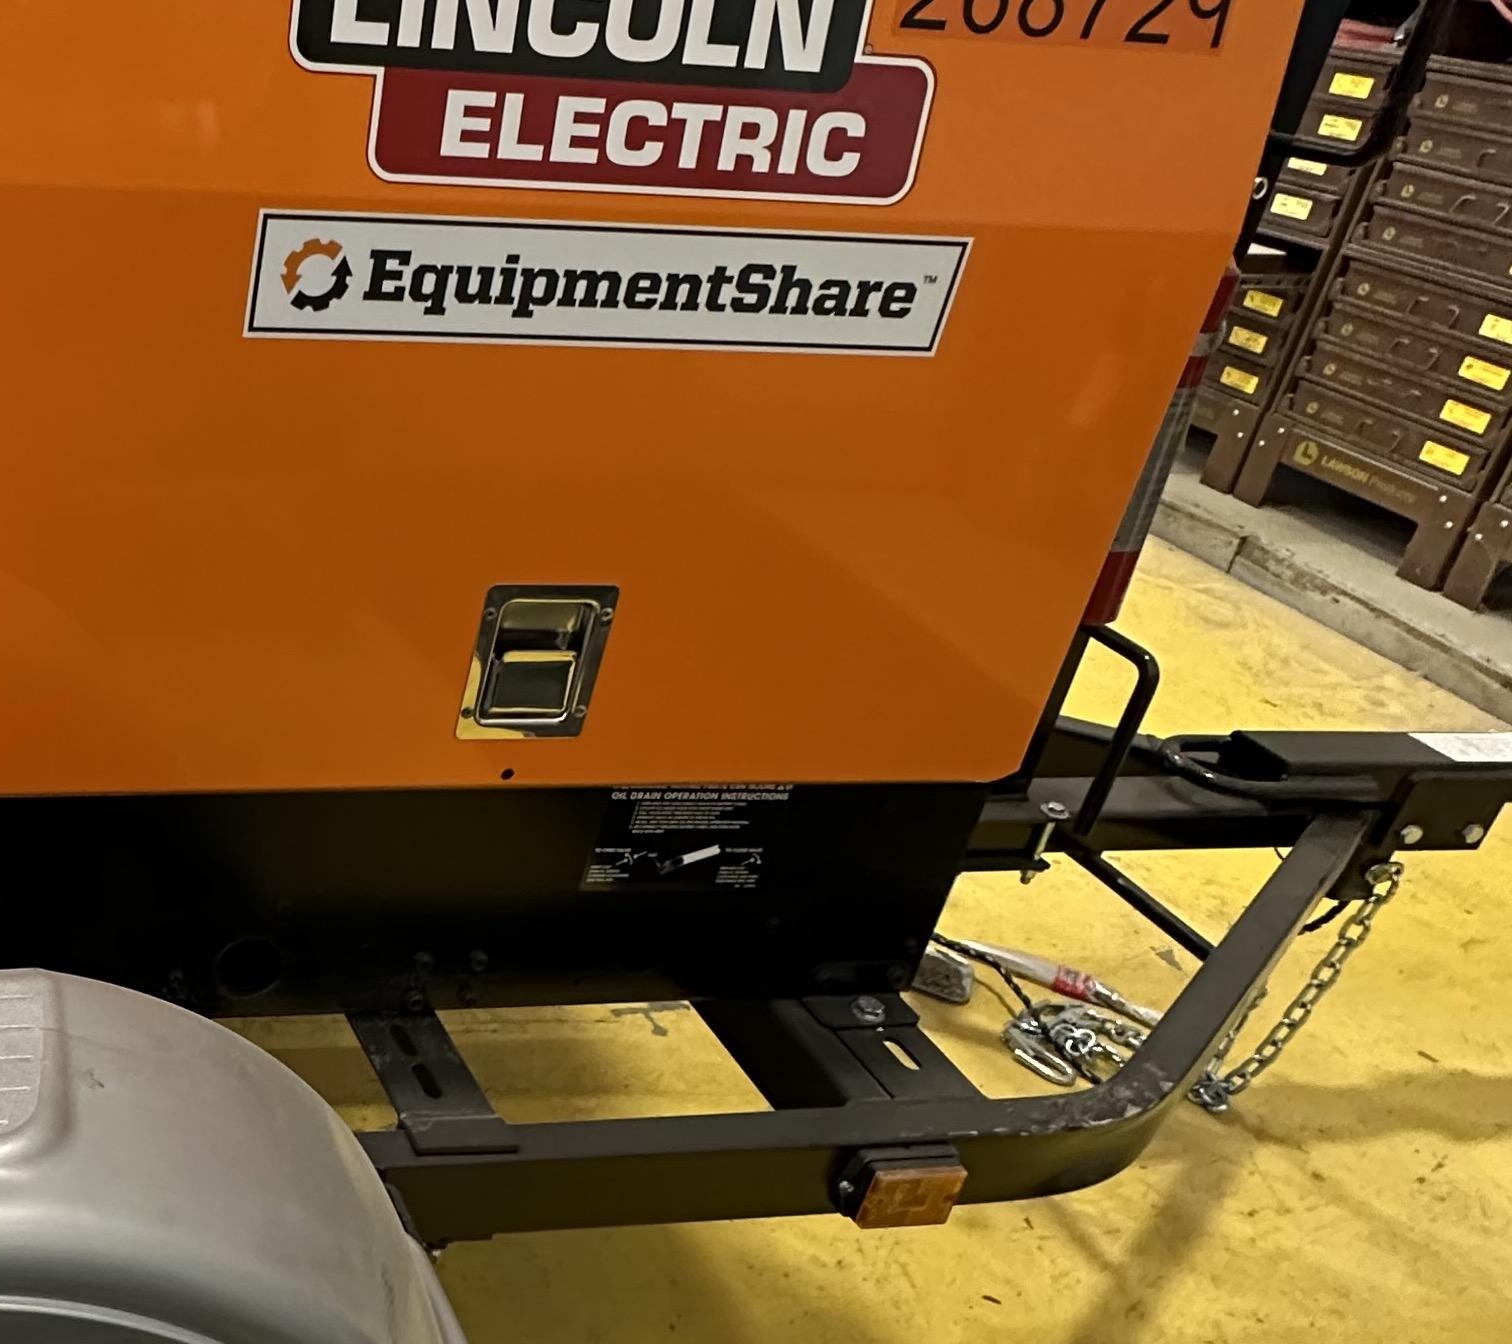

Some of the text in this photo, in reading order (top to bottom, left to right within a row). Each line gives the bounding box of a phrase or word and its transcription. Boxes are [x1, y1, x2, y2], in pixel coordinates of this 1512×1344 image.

[440, 89, 867, 179] ELECTRIC
[611, 791, 789, 801] OIL DRAIN OPERATION INSTRUCTIONS
